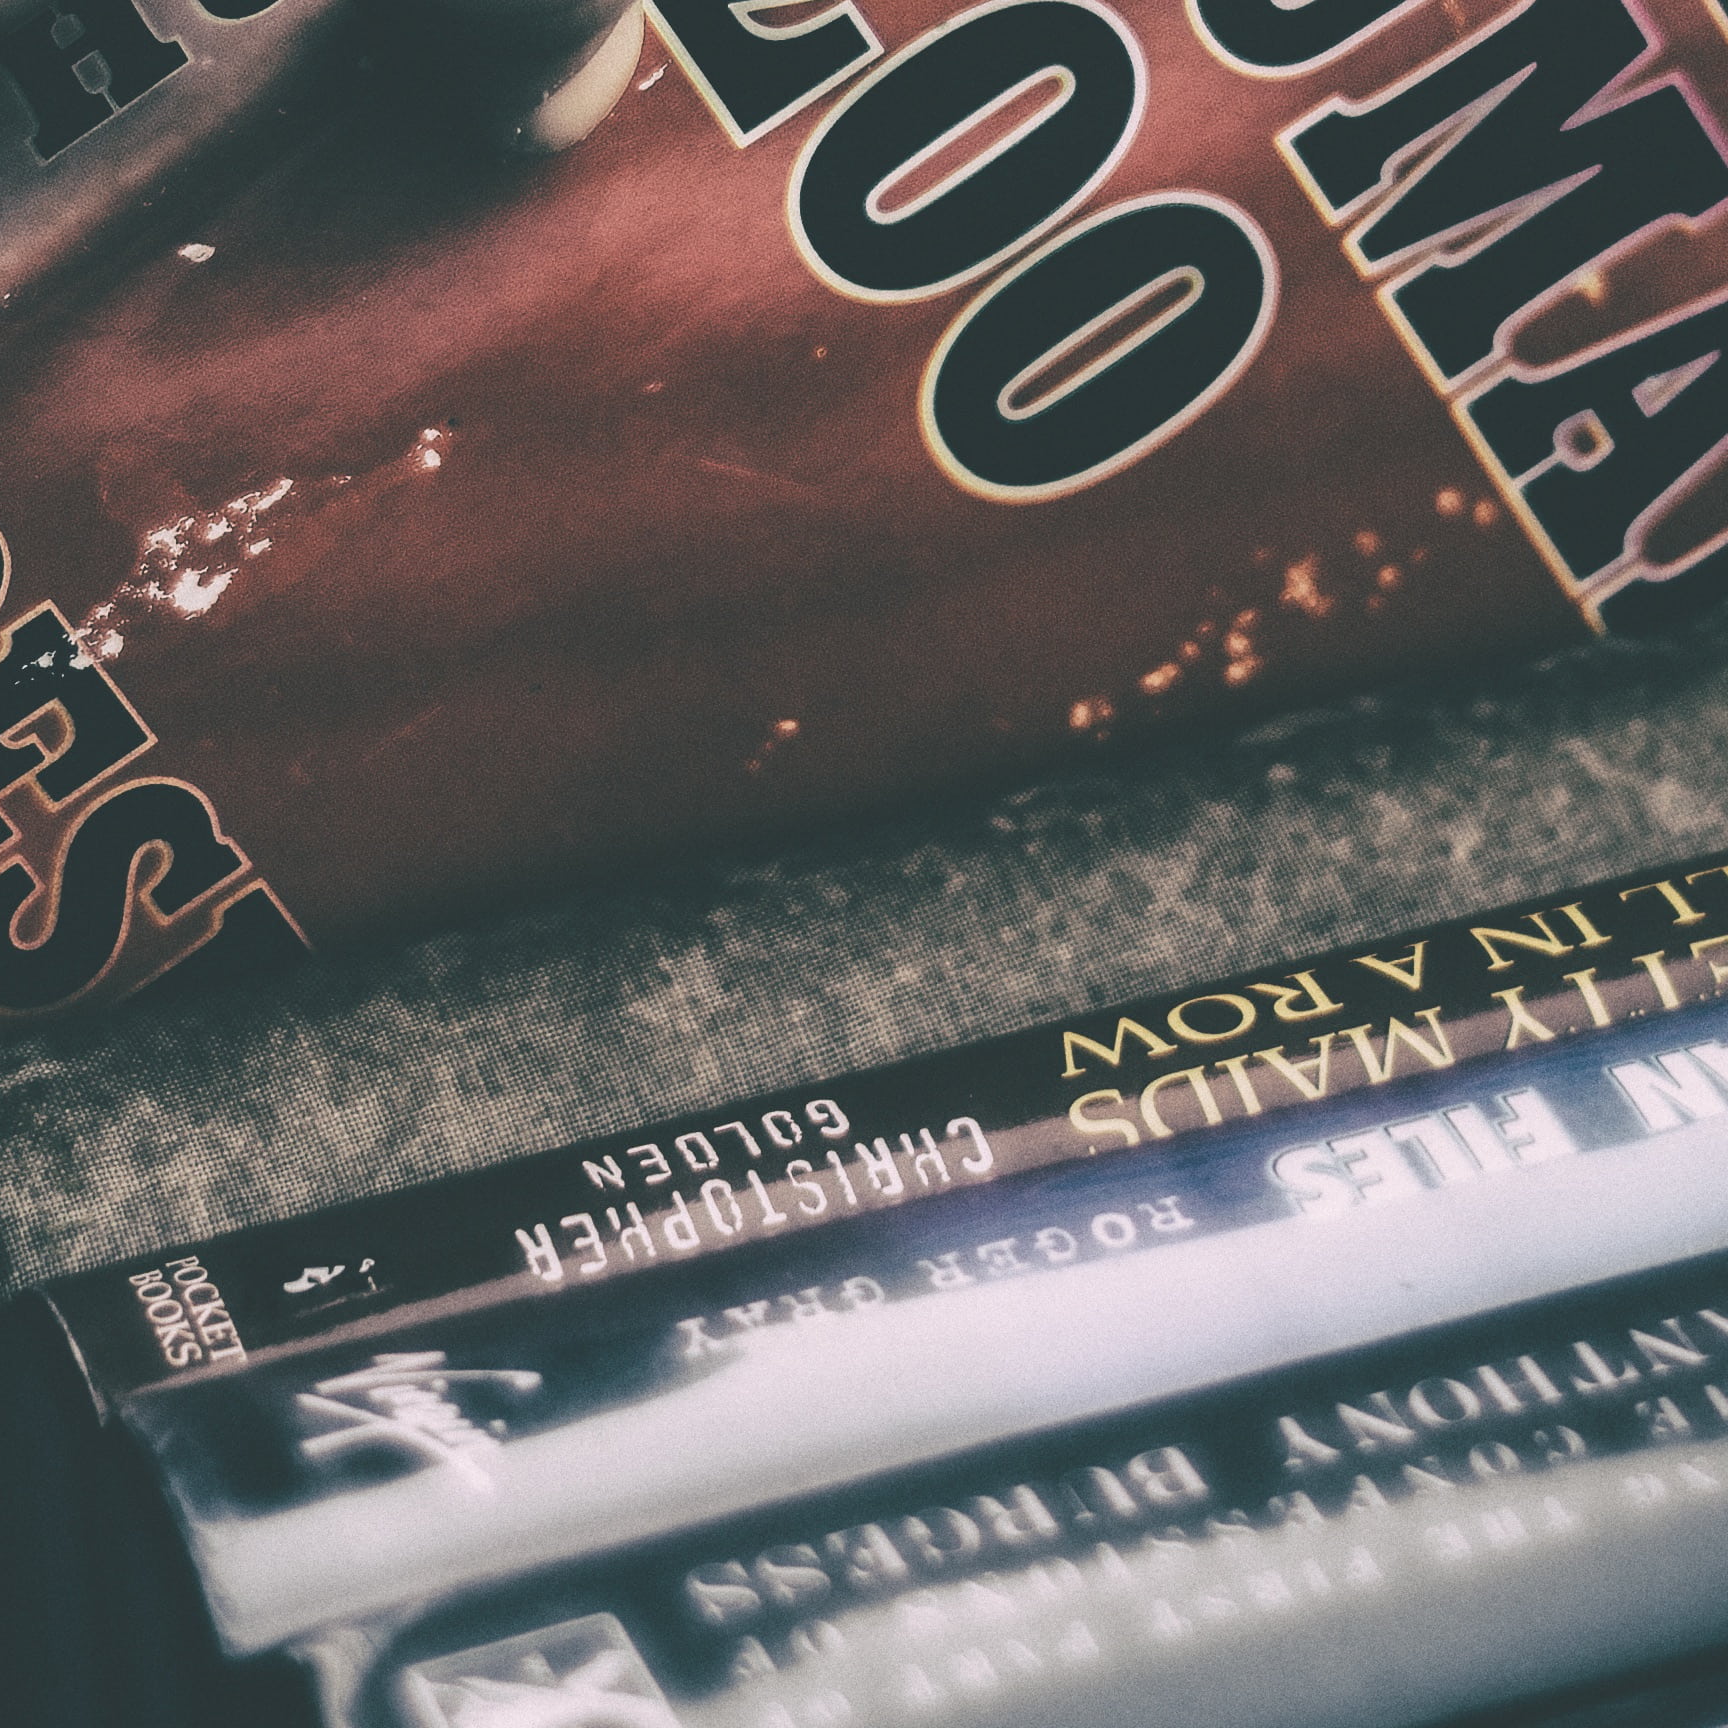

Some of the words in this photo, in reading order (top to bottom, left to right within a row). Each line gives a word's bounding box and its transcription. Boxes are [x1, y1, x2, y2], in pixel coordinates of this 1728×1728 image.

[1351, 940, 1431, 992] A
[1469, 900, 1614, 973] IN
[1059, 970, 1344, 1079] ROW
[1068, 1005, 1456, 1149] MAIDS
[580, 1097, 853, 1192] GOLDEN
[1267, 1089, 1578, 1220] FILES
[513, 1115, 997, 1285] CHRISTOPHER
[918, 1192, 1196, 1293] ROGER
[128, 1268, 203, 1368] BOOKS
[164, 1254, 249, 1363] POCKET
[676, 1274, 886, 1356] GRAY
[684, 1445, 1210, 1627] BURGESS
